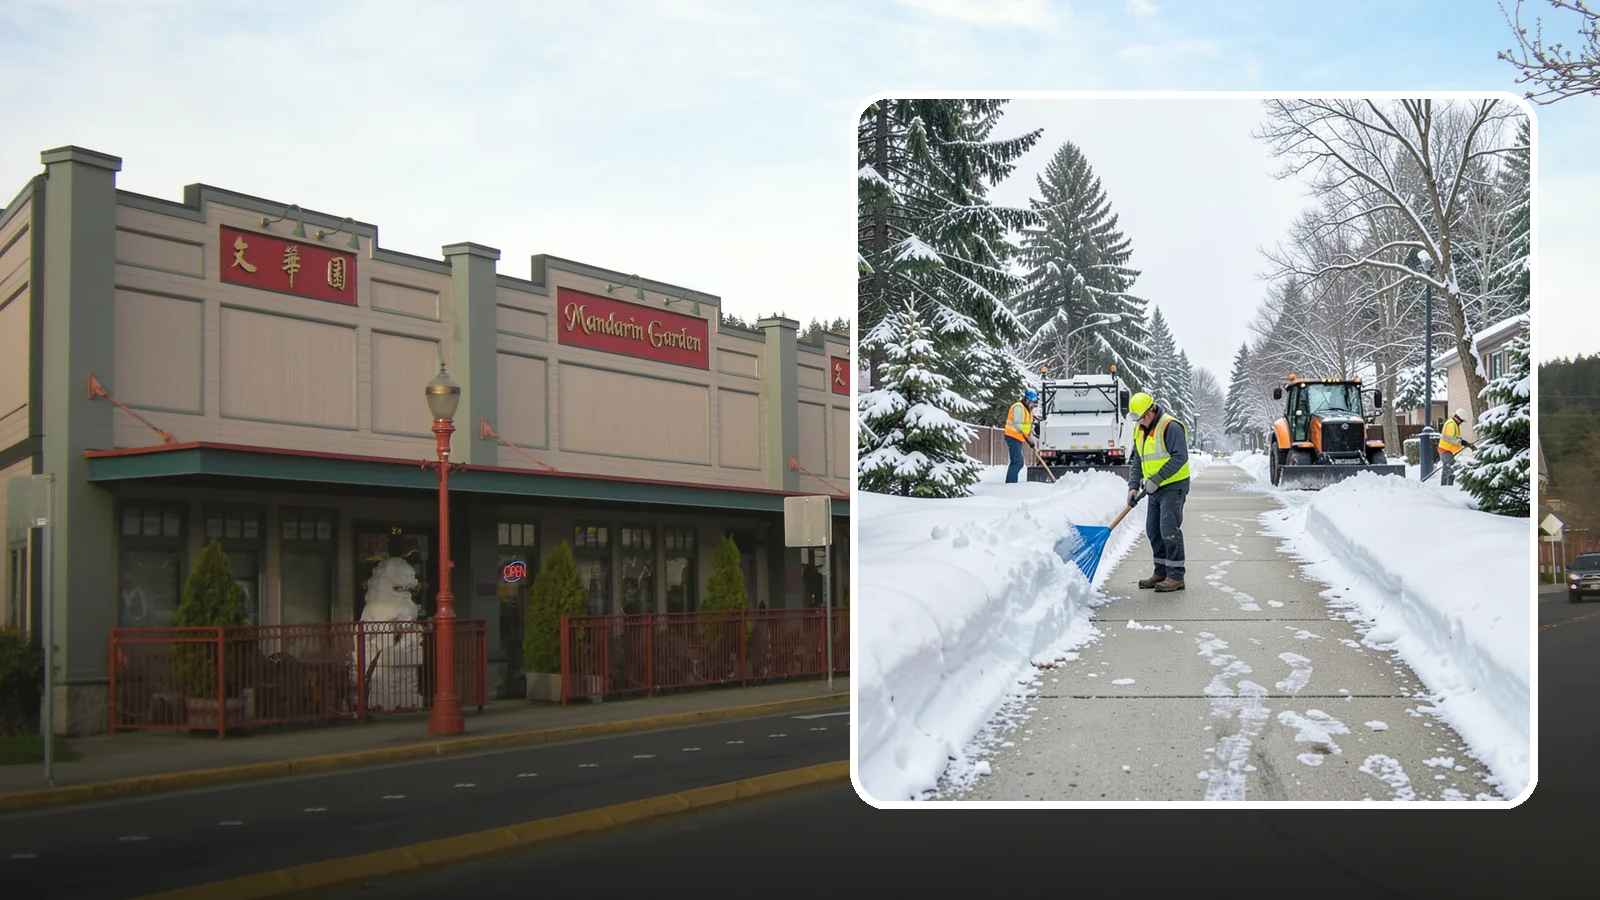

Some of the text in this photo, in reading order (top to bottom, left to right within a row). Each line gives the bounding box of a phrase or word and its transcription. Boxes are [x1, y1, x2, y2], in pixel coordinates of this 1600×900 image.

[564, 302, 701, 352] Mandarin Garden
[503, 565, 527, 578] OPEN
